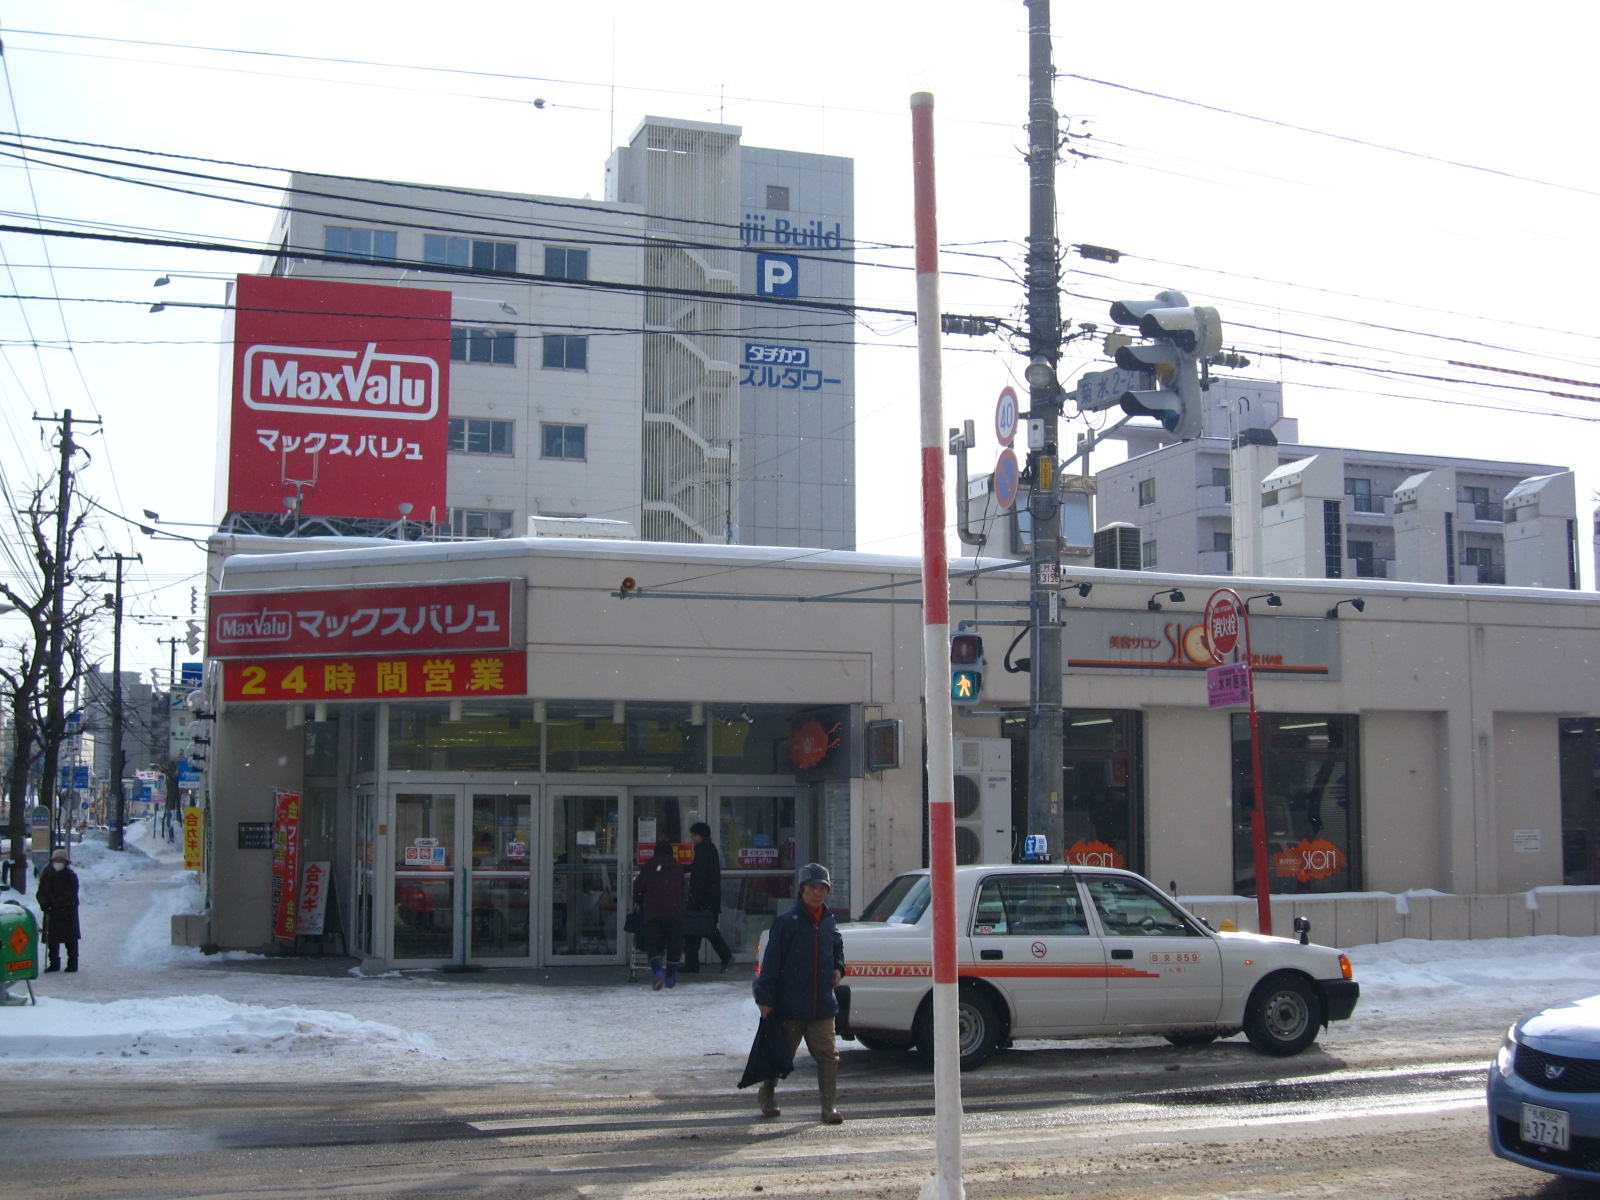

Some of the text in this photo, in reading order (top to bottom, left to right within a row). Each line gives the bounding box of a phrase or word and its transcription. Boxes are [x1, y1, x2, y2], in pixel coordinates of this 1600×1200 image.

[775, 218, 841, 250] Build
[764, 259, 793, 293] P
[749, 345, 807, 365] タチカワ
[261, 342, 426, 407] MaxValu
[999, 402, 1014, 429] 40
[256, 428, 424, 461] マックスバリュ
[223, 607, 286, 638] MaxValu
[297, 603, 500, 638] マックスバリュ
[1212, 613, 1237, 639] 消火栓
[1109, 635, 1162, 649] 美容サロン
[241, 657, 505, 695] 24時間営業
[1302, 850, 1336, 870] SION
[850, 965, 932, 976] NIKKO TAXI
[1176, 953, 1198, 962] 859
[1532, 1121, 1563, 1145] 37-21
